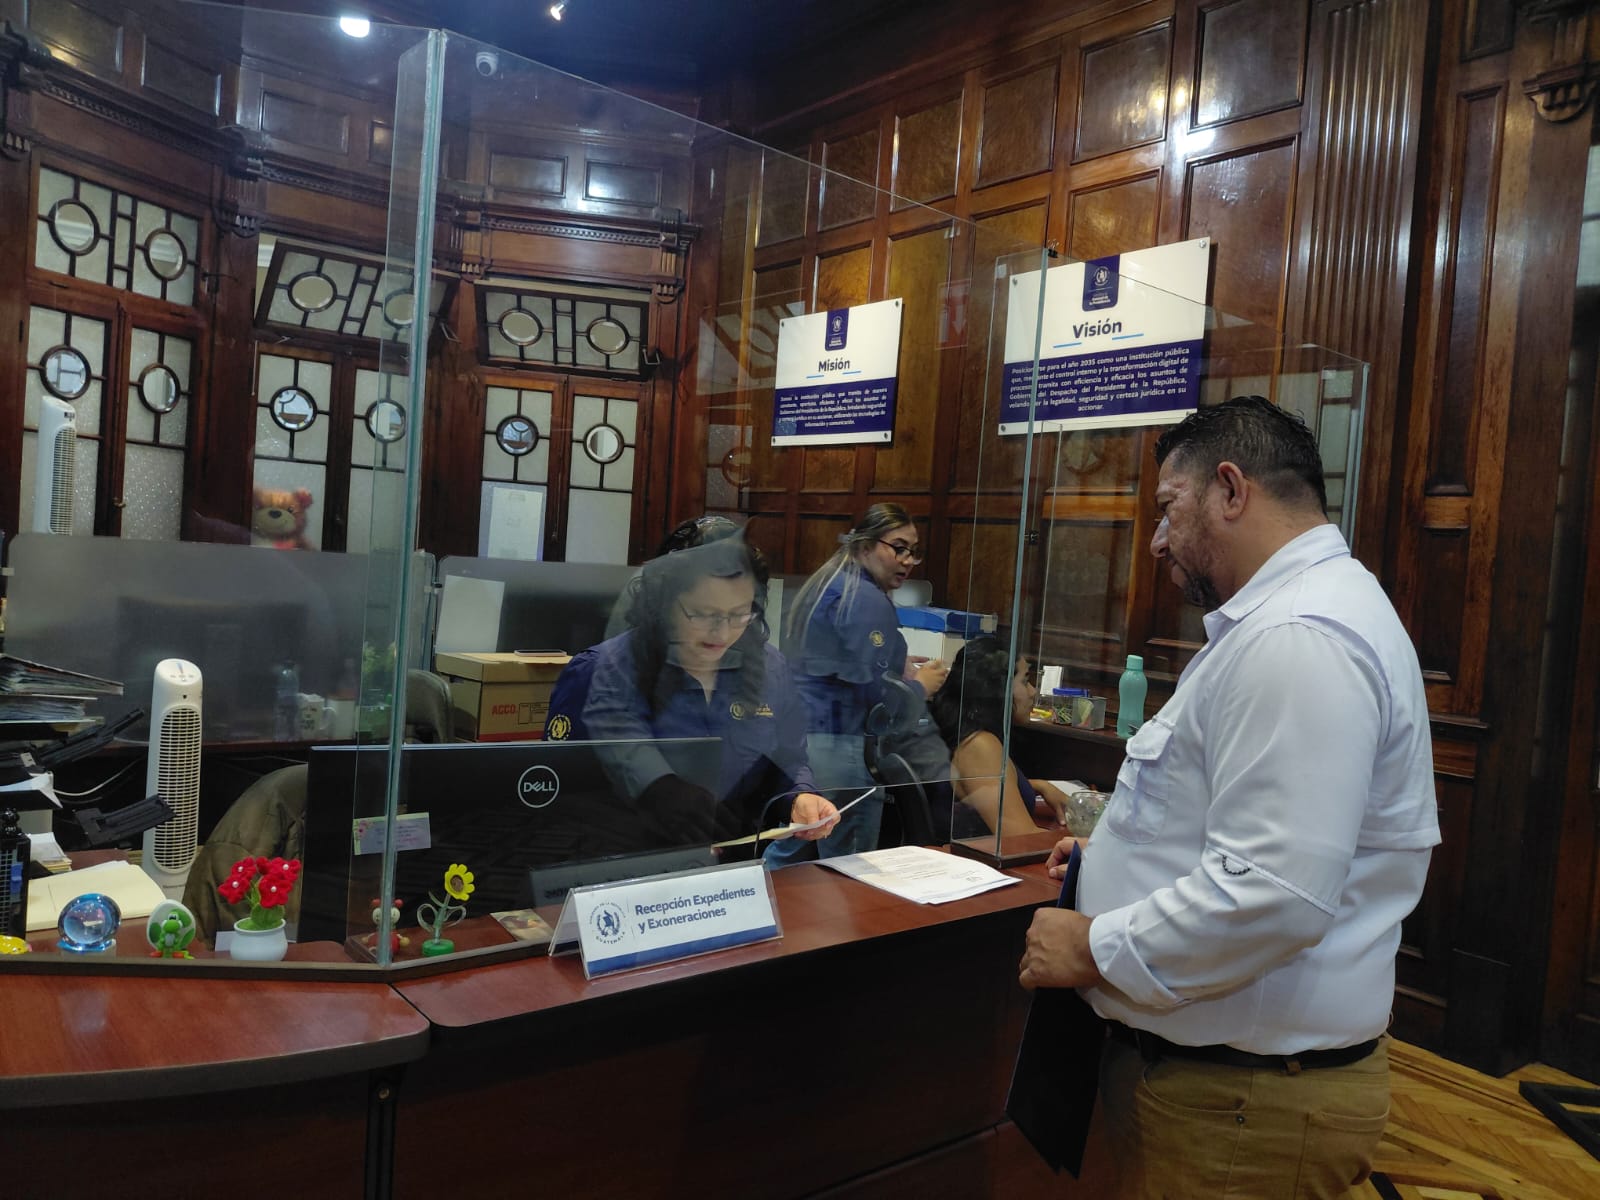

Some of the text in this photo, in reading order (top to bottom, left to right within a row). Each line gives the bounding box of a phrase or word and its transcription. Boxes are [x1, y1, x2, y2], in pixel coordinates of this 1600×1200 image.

[1073, 318, 1122, 339] Visión
[818, 358, 850, 372] Misión
[1080, 358, 1096, 367] 2035
[1165, 348, 1190, 357] pública
[1056, 370, 1076, 378] control
[1110, 361, 1158, 372] transformación
[1158, 357, 1179, 367] digital
[1074, 376, 1102, 385] eficiencia
[1111, 373, 1134, 381] eficacia
[1150, 369, 1176, 377] asuntos
[1153, 378, 1187, 386] República,
[1140, 388, 1165, 398] jurídica
[492, 704, 516, 716] ACCO
[524, 781, 555, 792] DELL
[635, 896, 692, 916] Recepción
[693, 888, 756, 906] Expedientes
[638, 908, 727, 934] y Exoneraciones
